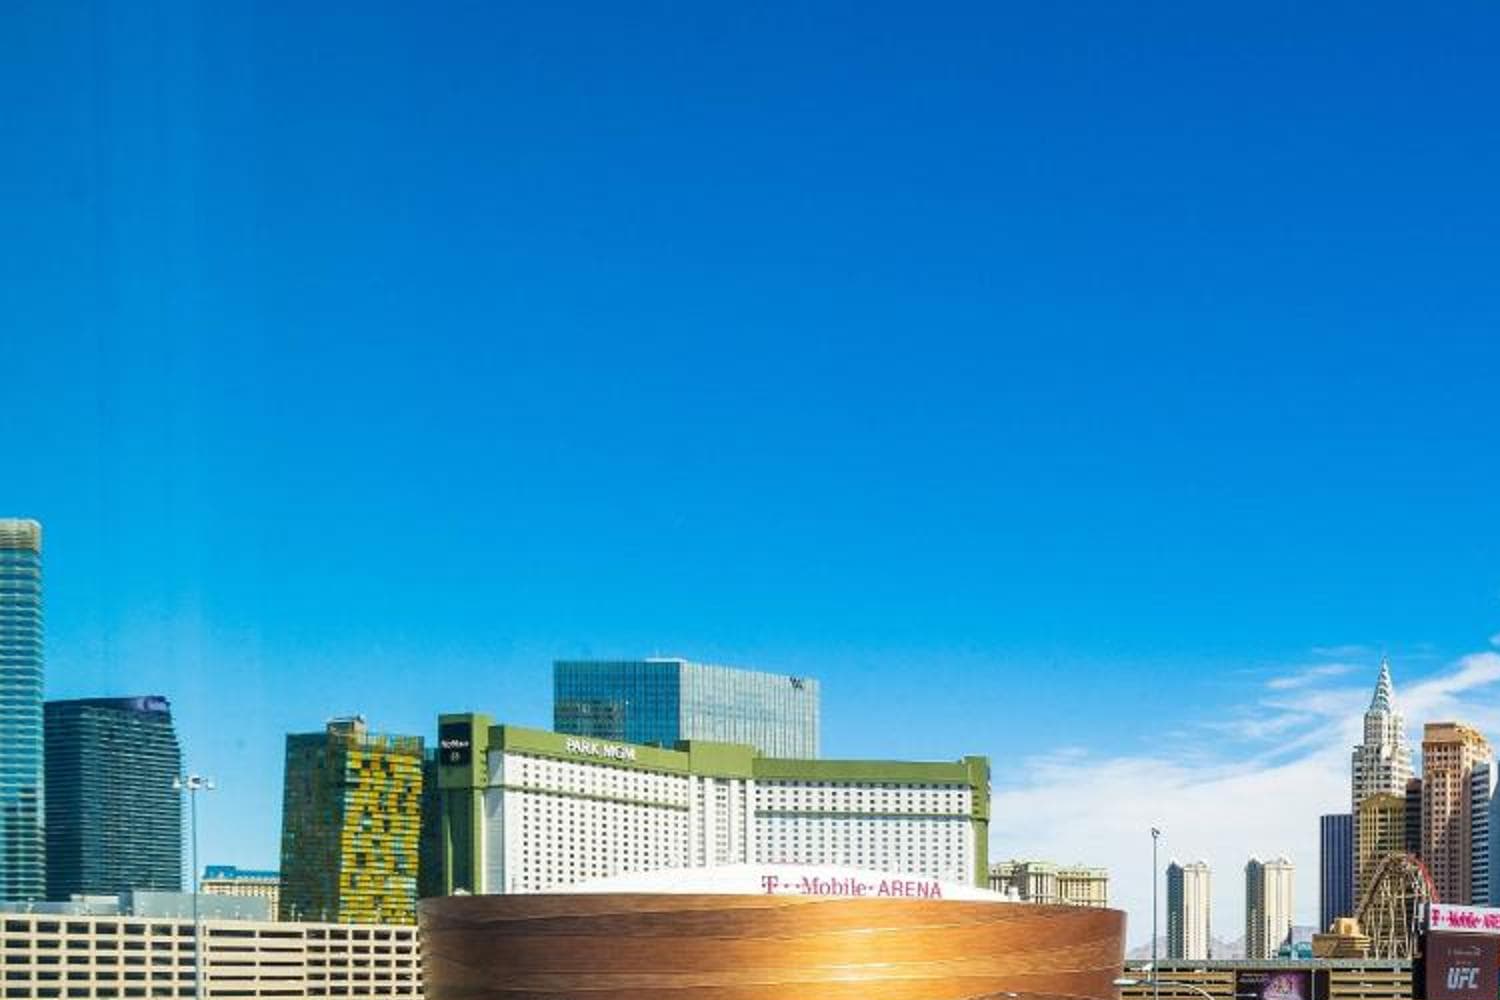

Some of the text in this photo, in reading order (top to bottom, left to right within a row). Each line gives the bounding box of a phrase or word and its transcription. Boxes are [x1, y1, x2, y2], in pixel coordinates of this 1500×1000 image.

[566, 737, 636, 761] PARK MGM
[878, 880, 942, 898] ARENA
[1447, 967, 1481, 989] UFC
